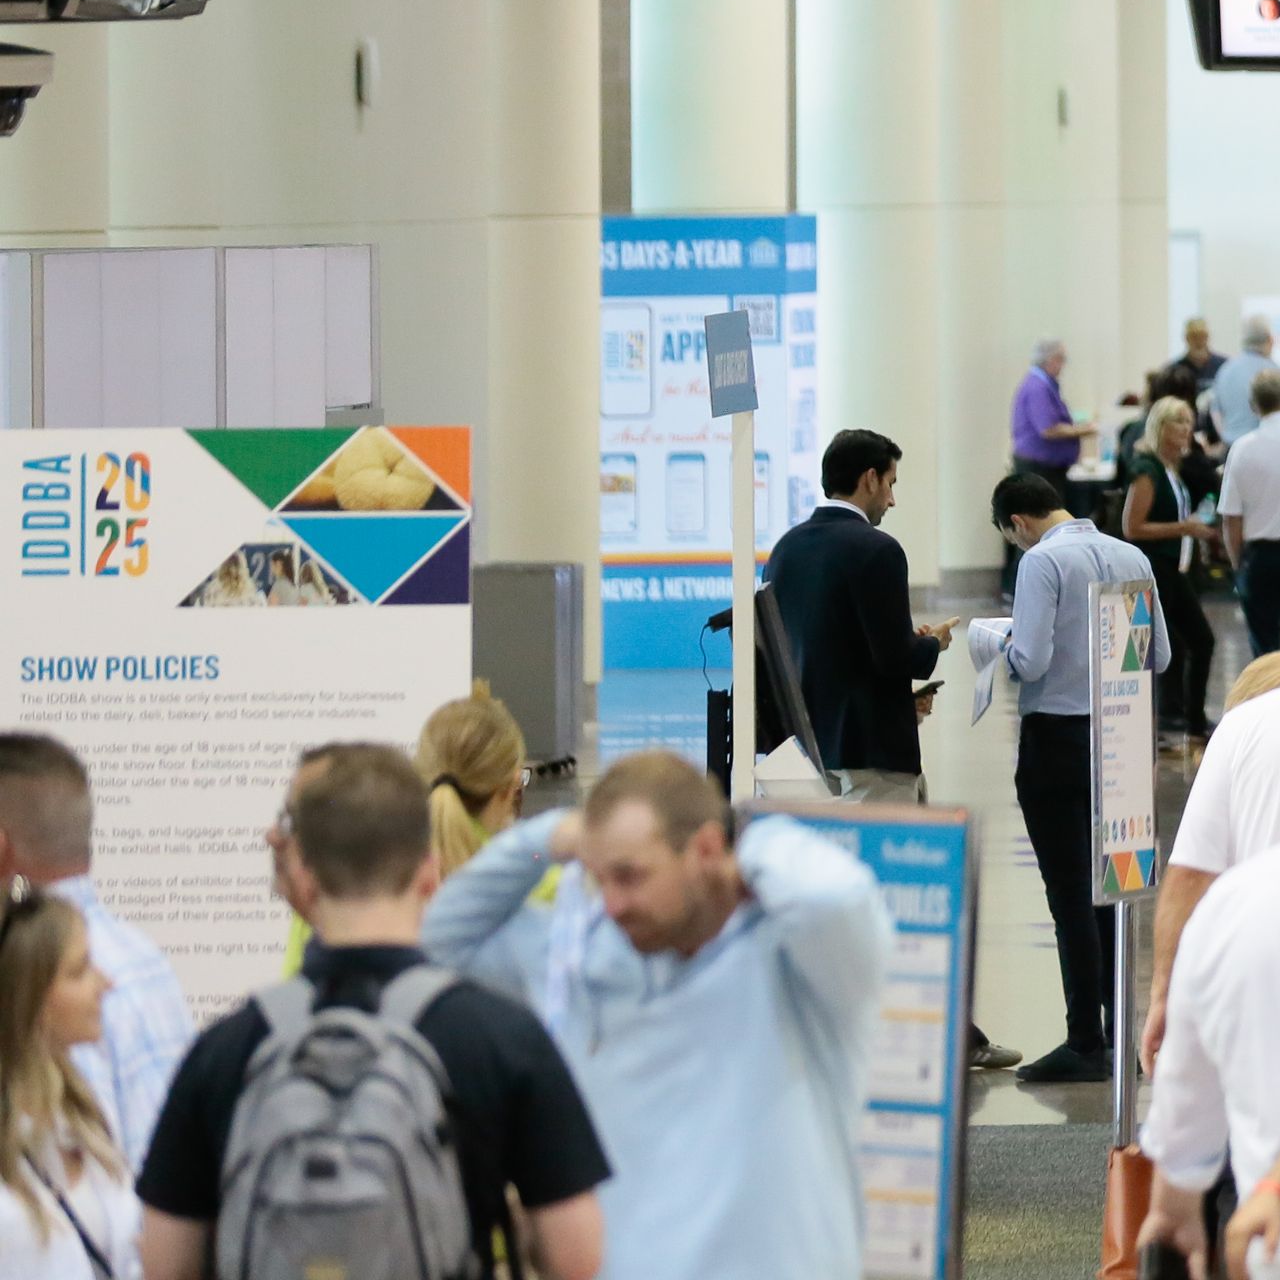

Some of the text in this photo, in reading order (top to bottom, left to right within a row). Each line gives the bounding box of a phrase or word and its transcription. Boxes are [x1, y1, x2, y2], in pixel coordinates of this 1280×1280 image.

[95, 452, 150, 511] 20
[22, 454, 72, 576] IDDBA
[95, 517, 151, 577] 25
[20, 655, 220, 681] SHOW POLICIES
